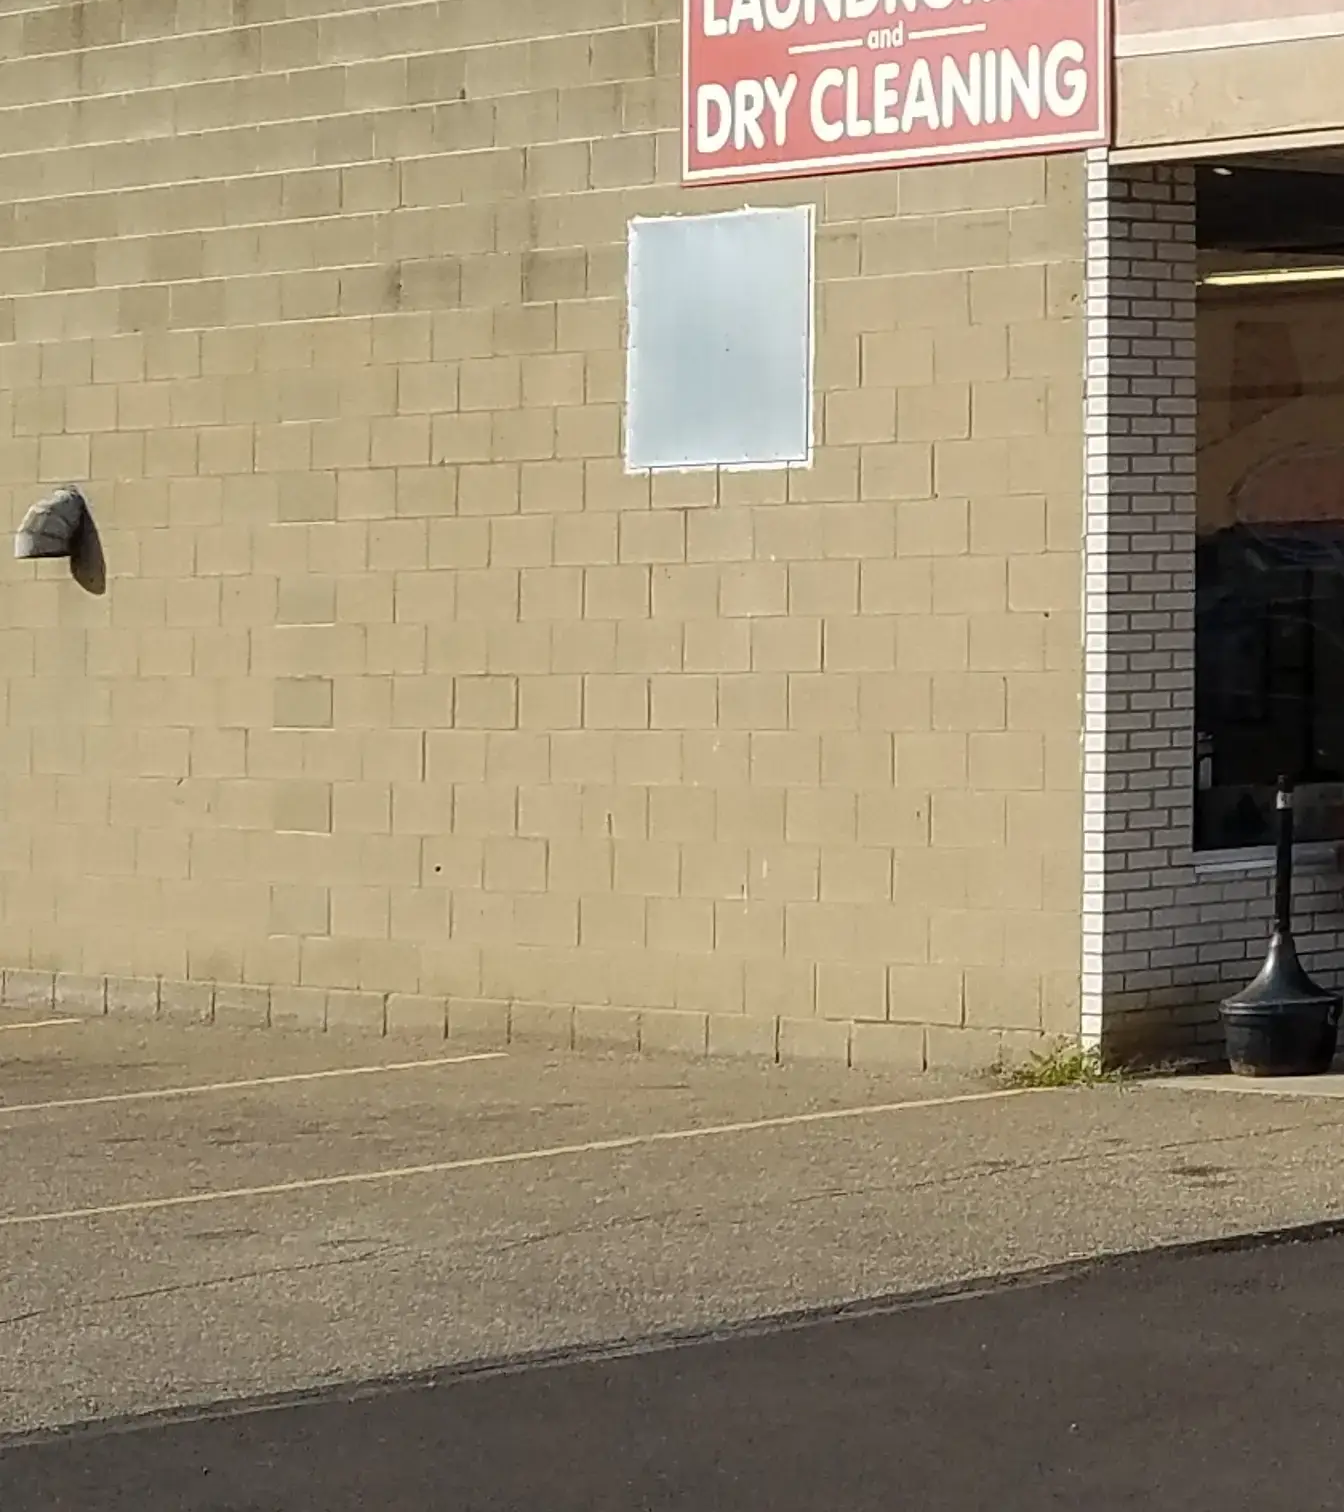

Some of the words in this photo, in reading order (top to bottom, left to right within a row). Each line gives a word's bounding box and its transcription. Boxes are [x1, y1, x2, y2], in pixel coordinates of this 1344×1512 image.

[867, 20, 905, 51] and
[696, 71, 798, 154] DRY
[809, 38, 1088, 143] CLEANING
